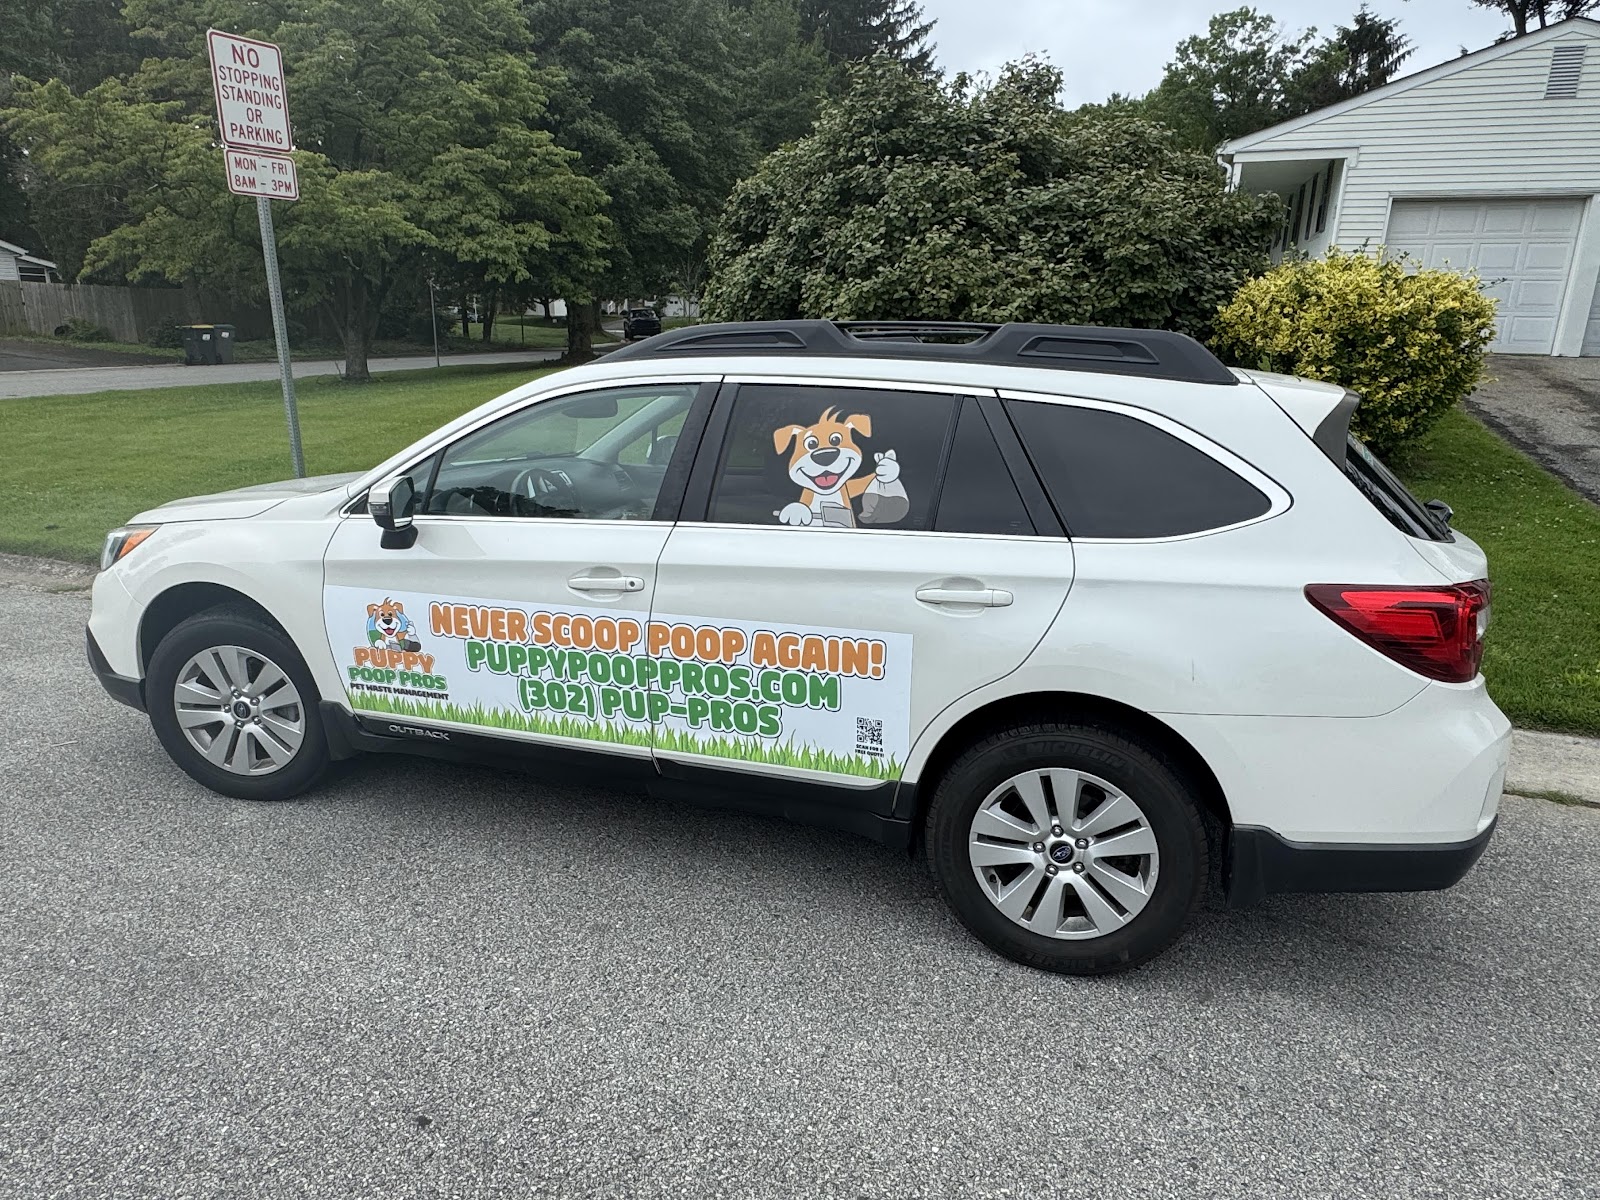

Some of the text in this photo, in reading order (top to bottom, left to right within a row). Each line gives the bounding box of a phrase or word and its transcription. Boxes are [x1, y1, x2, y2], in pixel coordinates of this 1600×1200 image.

[231, 43, 259, 68] NO
[219, 65, 280, 91] STOPPING
[221, 84, 282, 110] STANDING
[246, 107, 263, 124] OR
[230, 122, 283, 145] PARKING
[234, 156, 257, 172] MON
[271, 162, 288, 176] FRI
[234, 174, 257, 189] 8AM
[271, 179, 292, 193] 3PM
[429, 603, 885, 678] NEVER SCOOP POOP AGAIN!
[354, 647, 434, 674] PUPPY
[348, 667, 447, 690] POOP PROS
[466, 640, 840, 710] PUPPYPOOPPROS.COM
[350, 682, 449, 700] PET WASTE MANAGEMENT
[519, 678, 781, 737] (302) PUP-PROS
[388, 724, 450, 740] OUTBACK
[1026, 740, 1129, 769] MICHELIN
